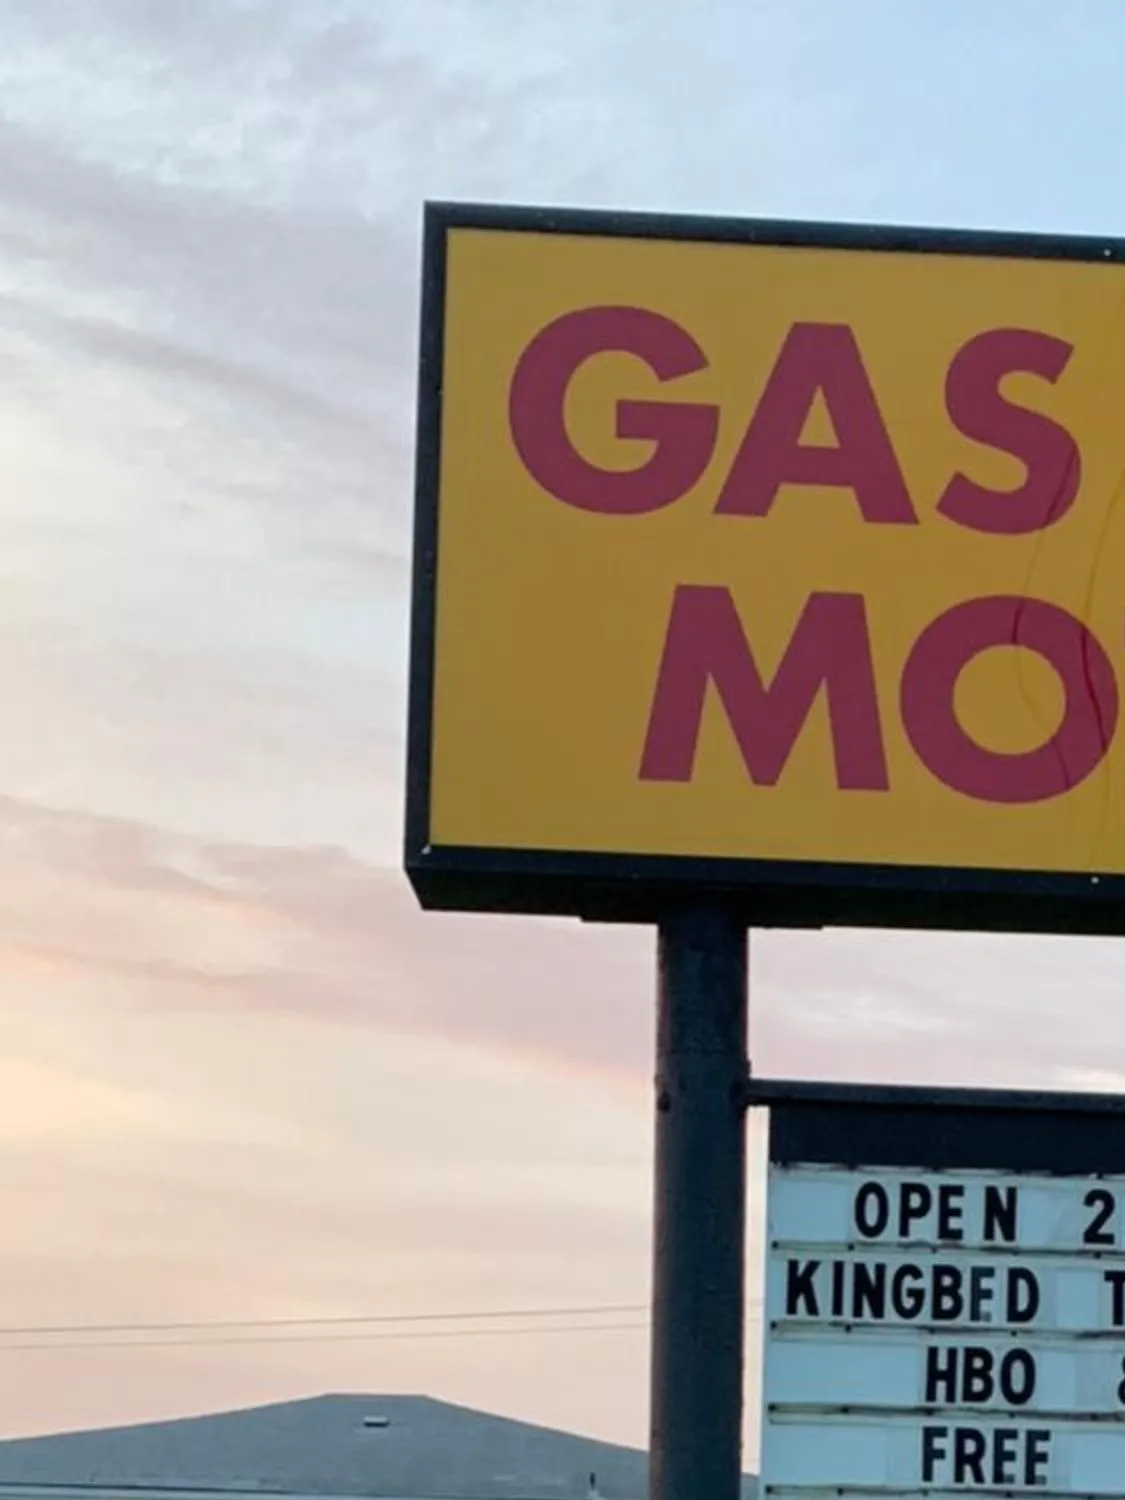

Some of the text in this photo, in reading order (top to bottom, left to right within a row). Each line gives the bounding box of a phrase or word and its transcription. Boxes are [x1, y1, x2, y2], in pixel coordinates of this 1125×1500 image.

[508, 304, 1083, 536] GAS
[854, 1181, 1018, 1241] OPEN
[786, 1260, 1040, 1323] KINGBED
[925, 1346, 1036, 1405] HBO
[921, 1427, 1052, 1486] FREE
